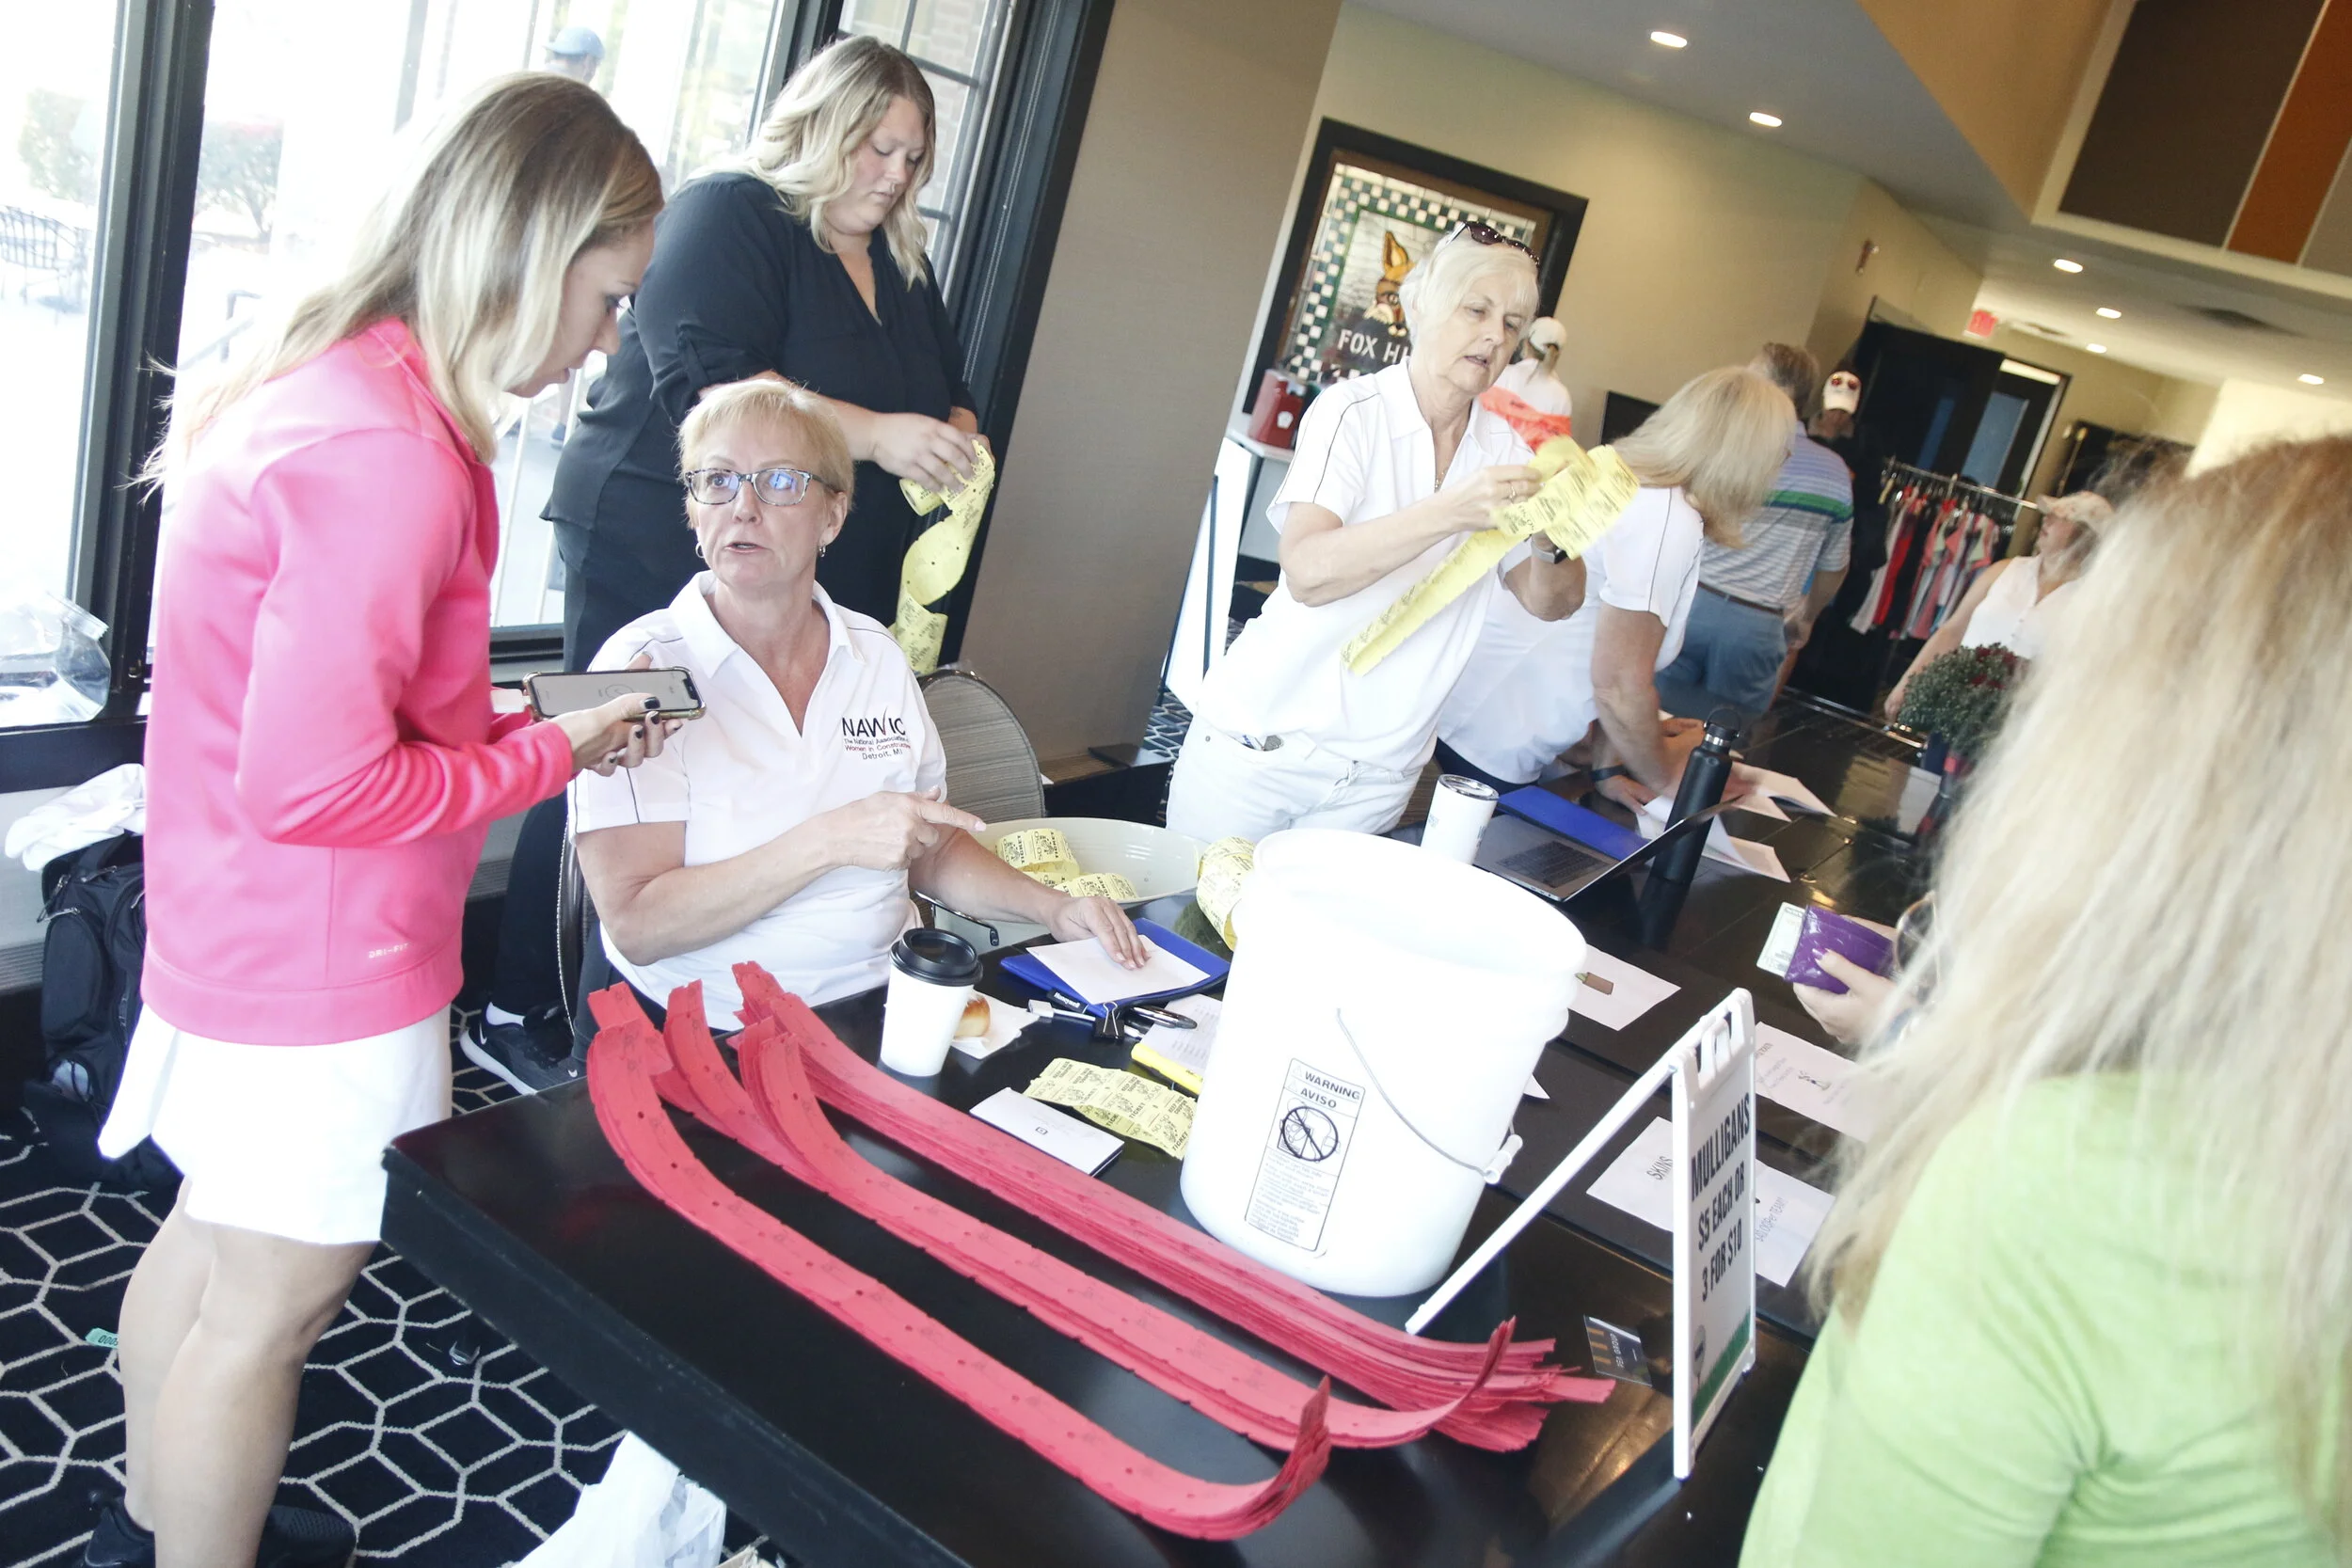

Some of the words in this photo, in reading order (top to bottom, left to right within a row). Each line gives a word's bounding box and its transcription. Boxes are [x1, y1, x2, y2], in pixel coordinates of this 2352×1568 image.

[1337, 328, 1378, 359] FOX
[842, 705, 906, 737] NAWIC
[1300, 1087, 1337, 1109] AVISO
[1305, 1070, 1360, 1101] WARNING
[1692, 1092, 1750, 1202] MULLIGANS
[1698, 1208, 1710, 1253] $5
[1712, 1175, 1733, 1233] EACH
[1735, 1160, 1744, 1202] OR
[1702, 1266, 1708, 1302] 3
[1710, 1241, 1726, 1292] FOR
[1728, 1218, 1741, 1266] $10
